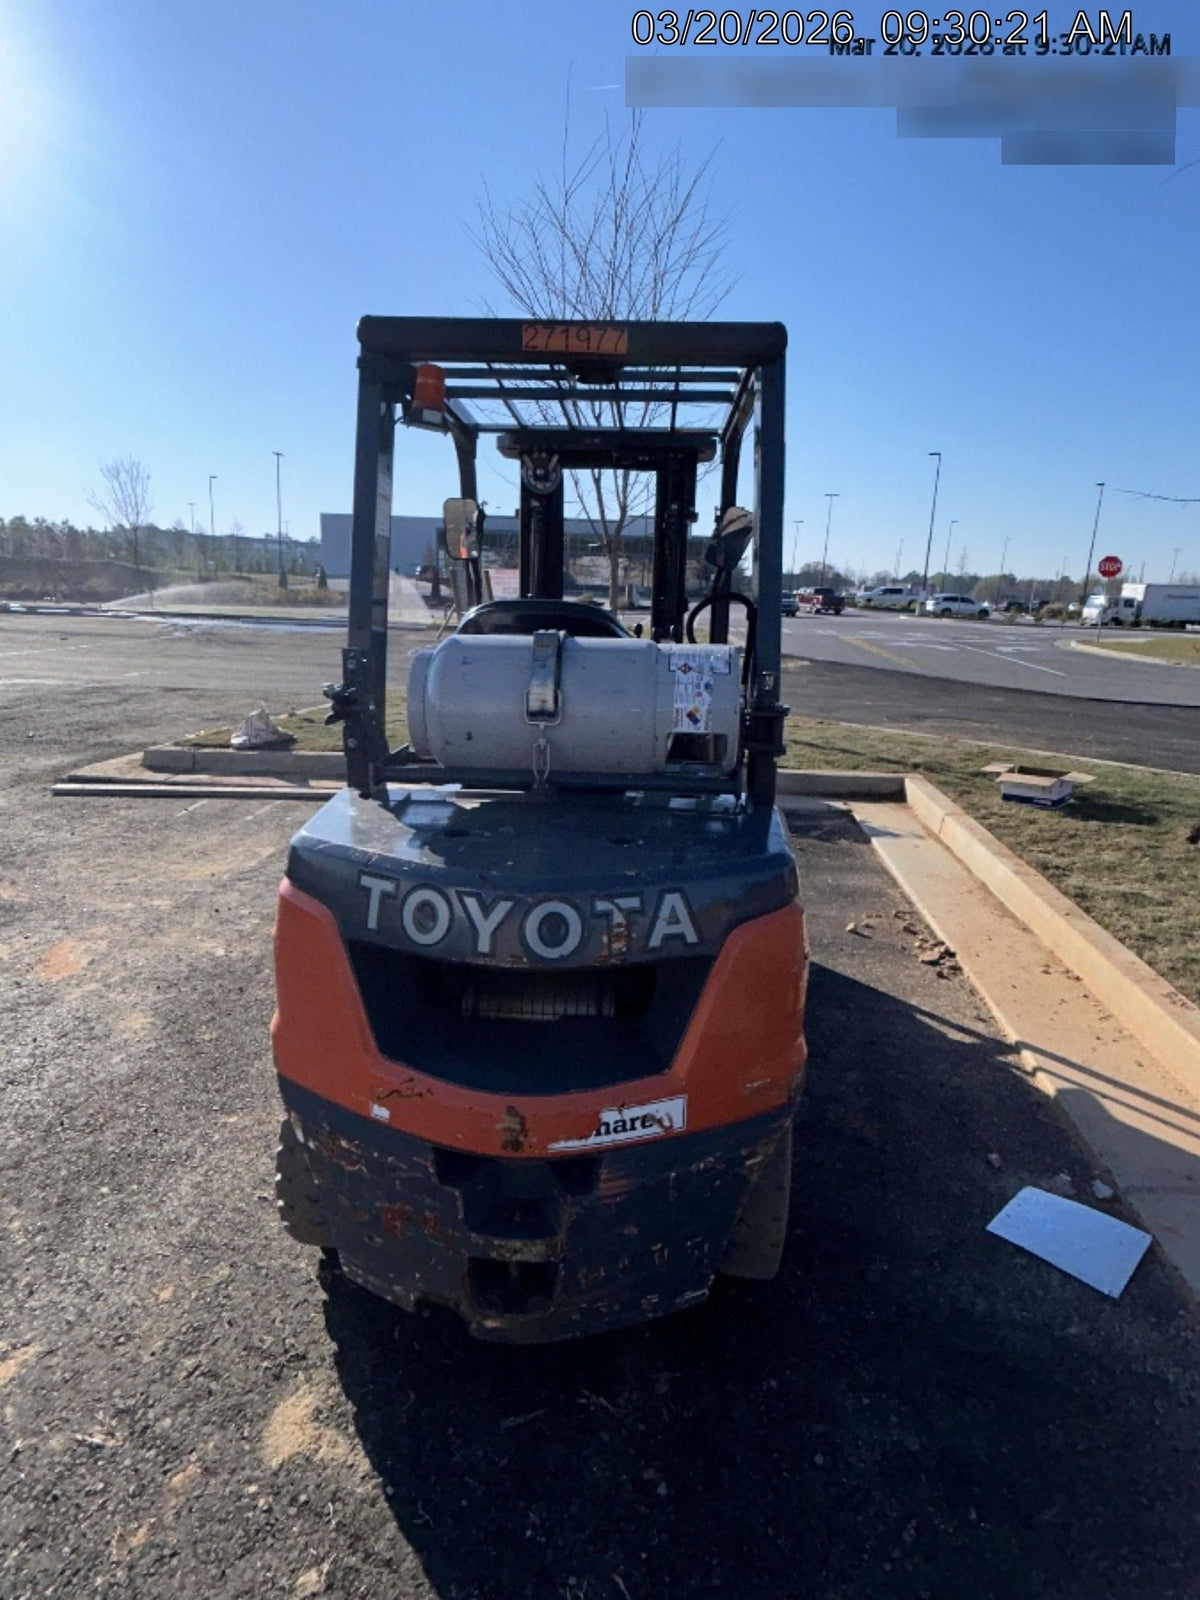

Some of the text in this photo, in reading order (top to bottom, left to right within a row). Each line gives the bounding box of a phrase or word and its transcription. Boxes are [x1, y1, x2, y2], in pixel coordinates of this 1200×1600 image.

[523, 325, 625, 352] 271977
[1100, 561, 1120, 571] STOP
[359, 875, 699, 959] TOYOTA
